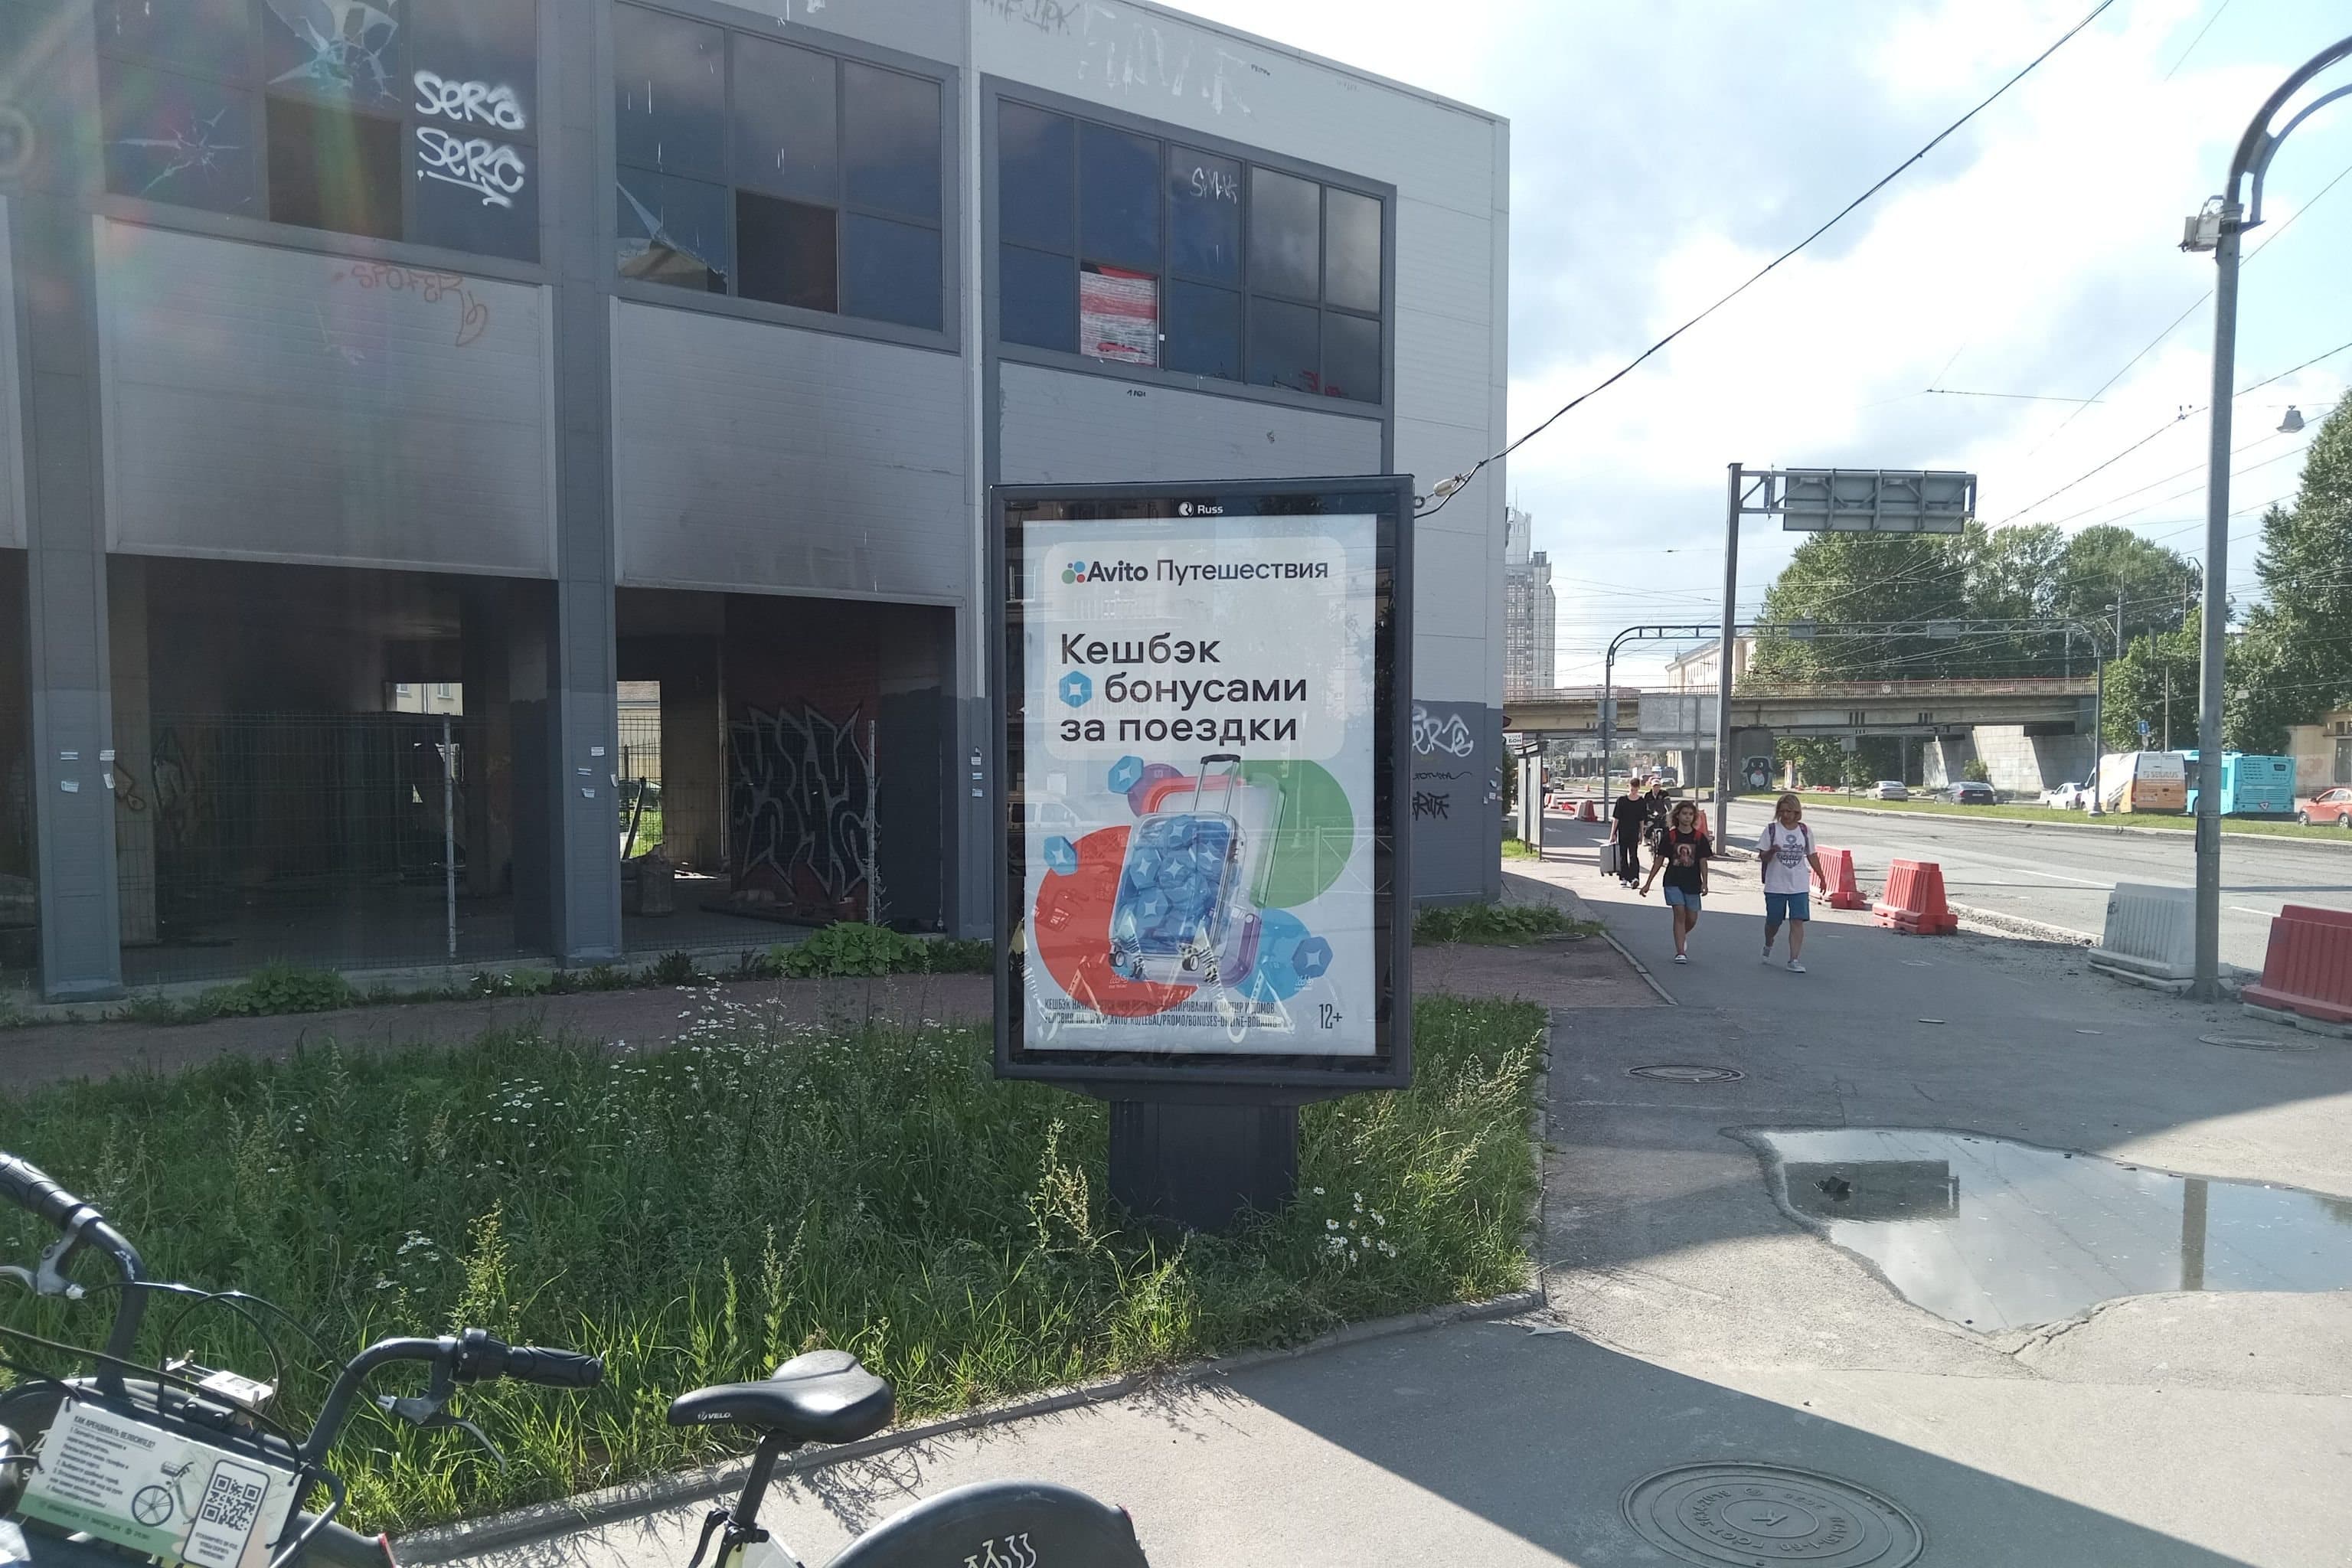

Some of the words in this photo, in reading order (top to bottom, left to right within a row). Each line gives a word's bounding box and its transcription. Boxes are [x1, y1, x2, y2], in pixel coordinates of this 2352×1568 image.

[1197, 505, 1223, 514] Russ
[1086, 560, 1149, 583] Avito
[1157, 559, 1329, 586] Путешествия
[1061, 632, 1220, 665] Кешбэк
[1105, 671, 1307, 710] бонусами
[1060, 718, 1106, 742] за
[1119, 717, 1297, 746] поездки
[1044, 998, 1071, 1011] КЕШБЭК
[1318, 1003, 1343, 1029] 12+
